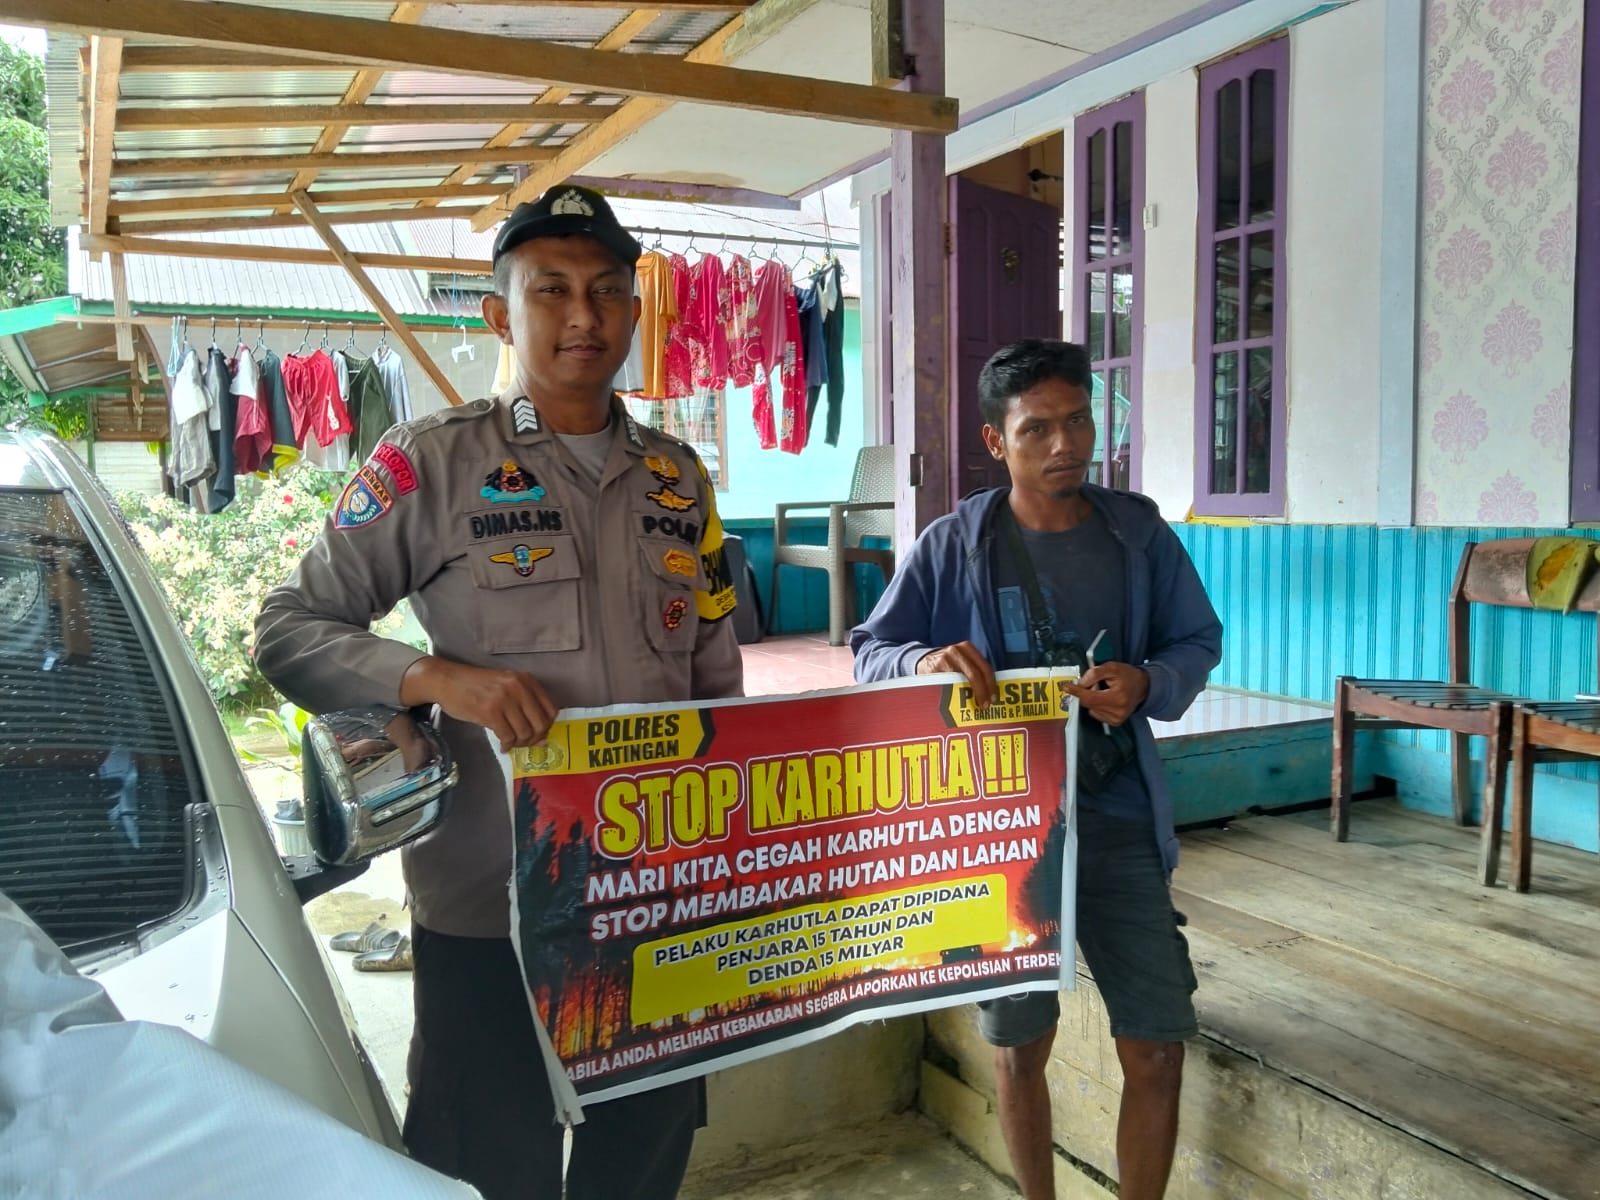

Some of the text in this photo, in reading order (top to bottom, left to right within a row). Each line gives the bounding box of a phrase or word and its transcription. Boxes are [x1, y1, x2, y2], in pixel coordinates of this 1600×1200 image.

[959, 681, 1049, 708] PLSEK
[1009, 707, 1014, 717] &
[1023, 703, 1049, 715] MALAN
[588, 713, 680, 746] POLRES
[588, 739, 680, 768] KATINGAN
[602, 733, 1027, 853] STOP KARHUTLA !!!
[587, 805, 1041, 903] MARI KITA CEGAH KARHUTLA DENGAN
[591, 838, 1038, 940] STOP MEMBAKAR HUTAN DAN LAHAN
[655, 883, 990, 967] PELAKU KARHUTLA DAPAT DIPIDANA
[717, 911, 933, 972] PENJARA 15 TAHUN DAN
[749, 936, 904, 986] DENDA 15 MILYAR
[612, 1046, 655, 1070] ANDA
[658, 1025, 722, 1057] MELIHAT
[722, 1003, 803, 1035] KEBAKARAN
[805, 991, 848, 1014] SEGERA
[849, 973, 919, 999] LAPORKAN
[920, 970, 937, 984] KE
[938, 957, 1012, 983] KEPOLISIAN
